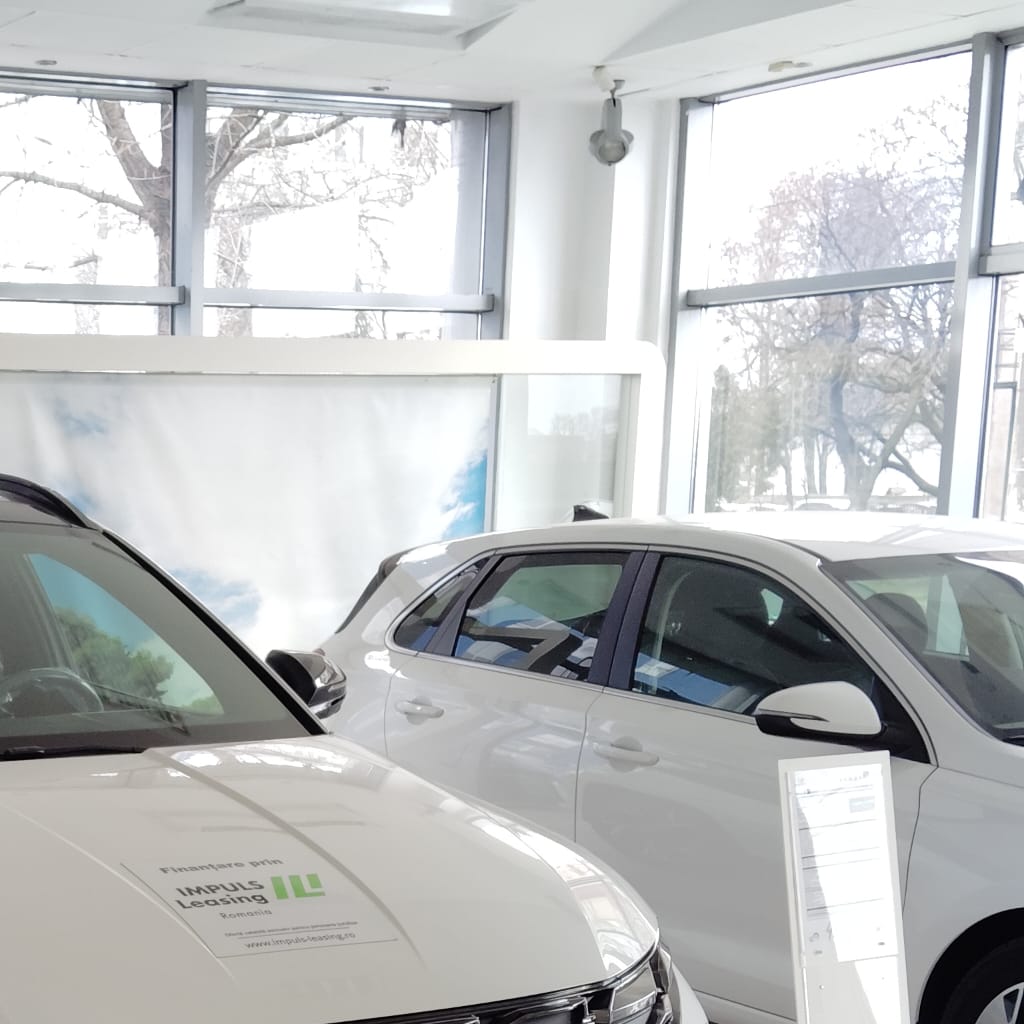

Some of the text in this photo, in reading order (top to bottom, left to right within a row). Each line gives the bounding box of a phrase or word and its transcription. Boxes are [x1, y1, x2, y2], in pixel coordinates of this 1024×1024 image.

[248, 859, 284, 868] prin
[176, 880, 265, 897] IMPULS
[175, 894, 270, 909] Leasing
[219, 909, 273, 920] Romania
[245, 932, 356, 949] www.impuls-leasing.ro
